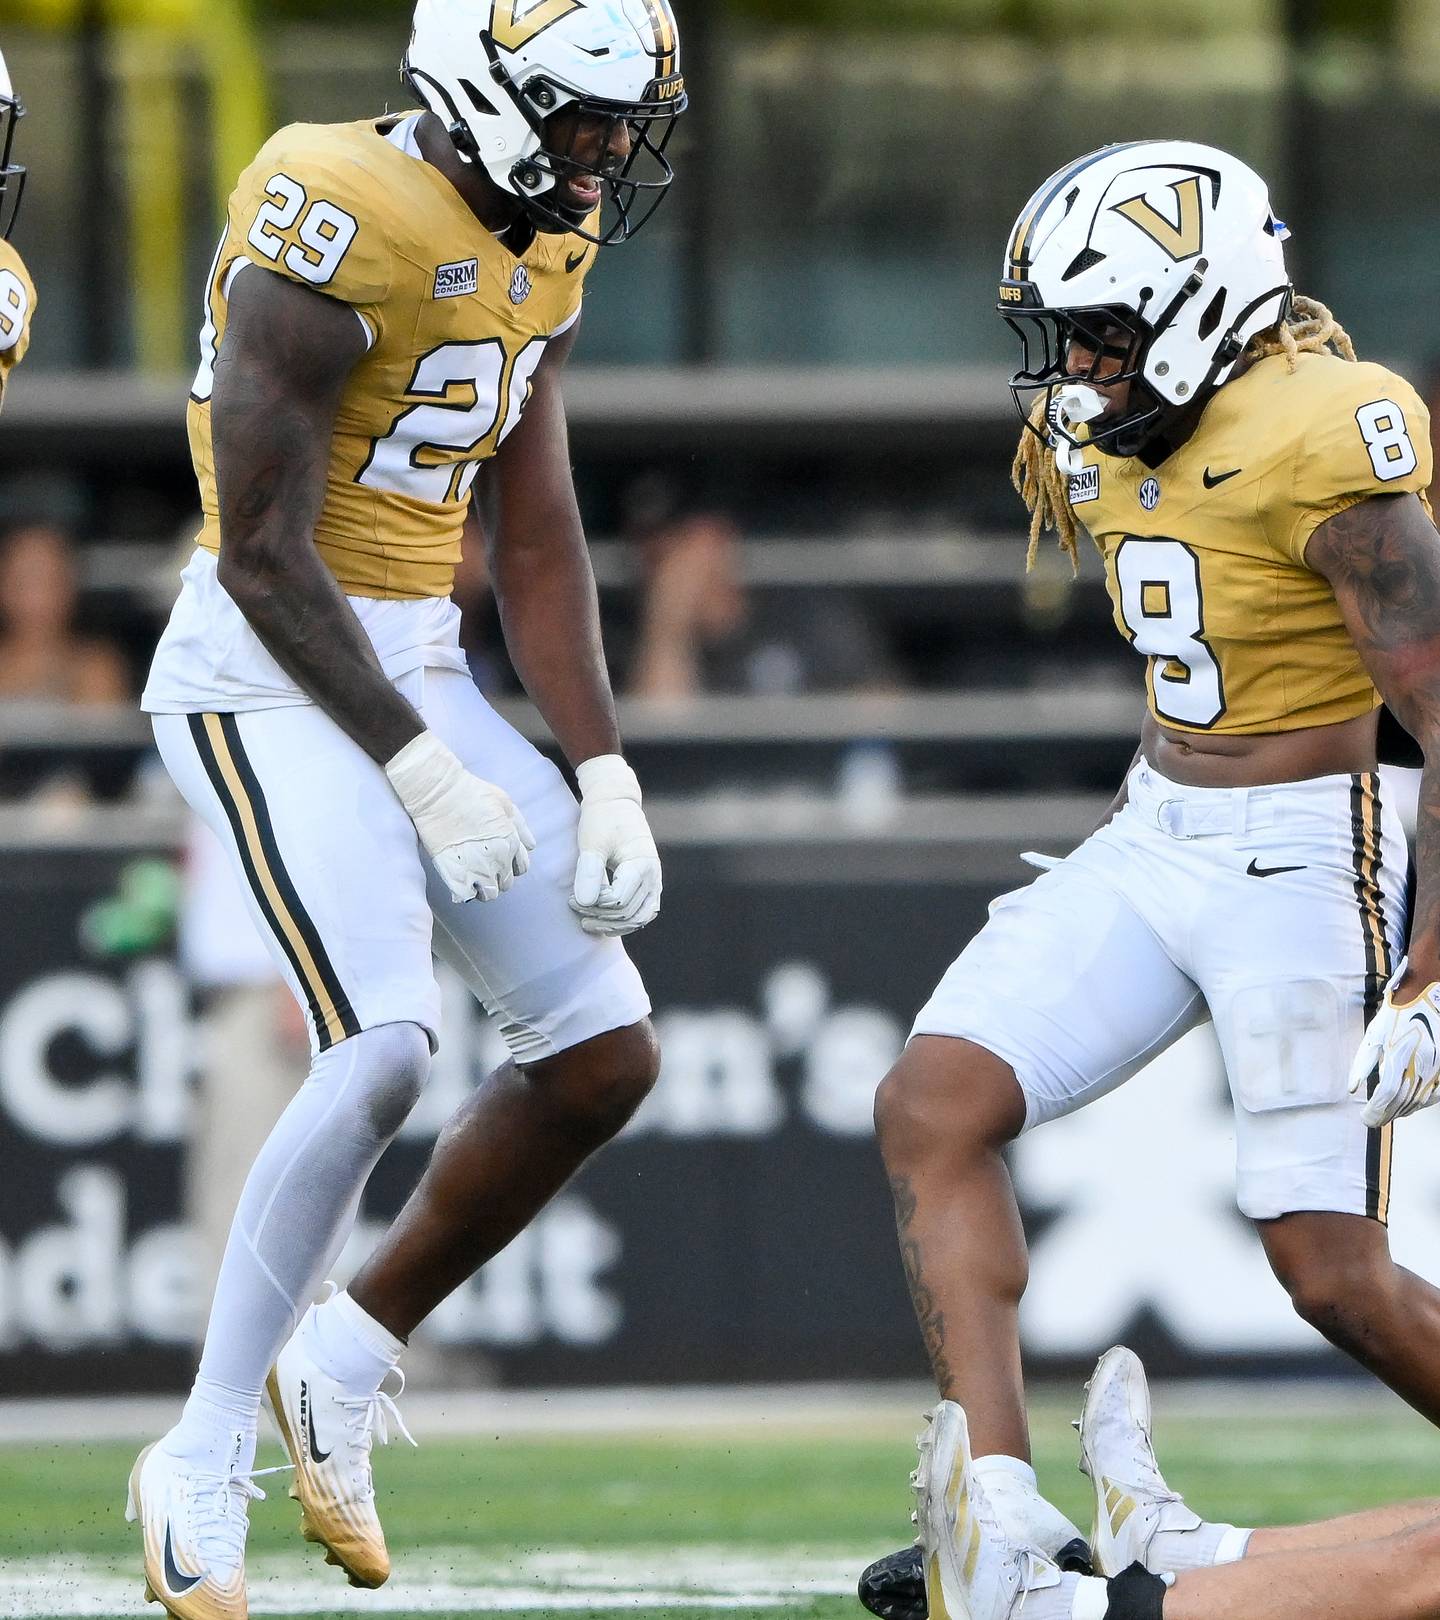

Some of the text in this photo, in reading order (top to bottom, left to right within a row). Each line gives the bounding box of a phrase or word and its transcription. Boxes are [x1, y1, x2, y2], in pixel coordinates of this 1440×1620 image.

[247, 172, 360, 285] 29
[1107, 175, 1203, 263] V
[435, 281, 476, 295] CONCRETE
[1354, 398, 1418, 482] 8
[1114, 536, 1227, 729] 8
